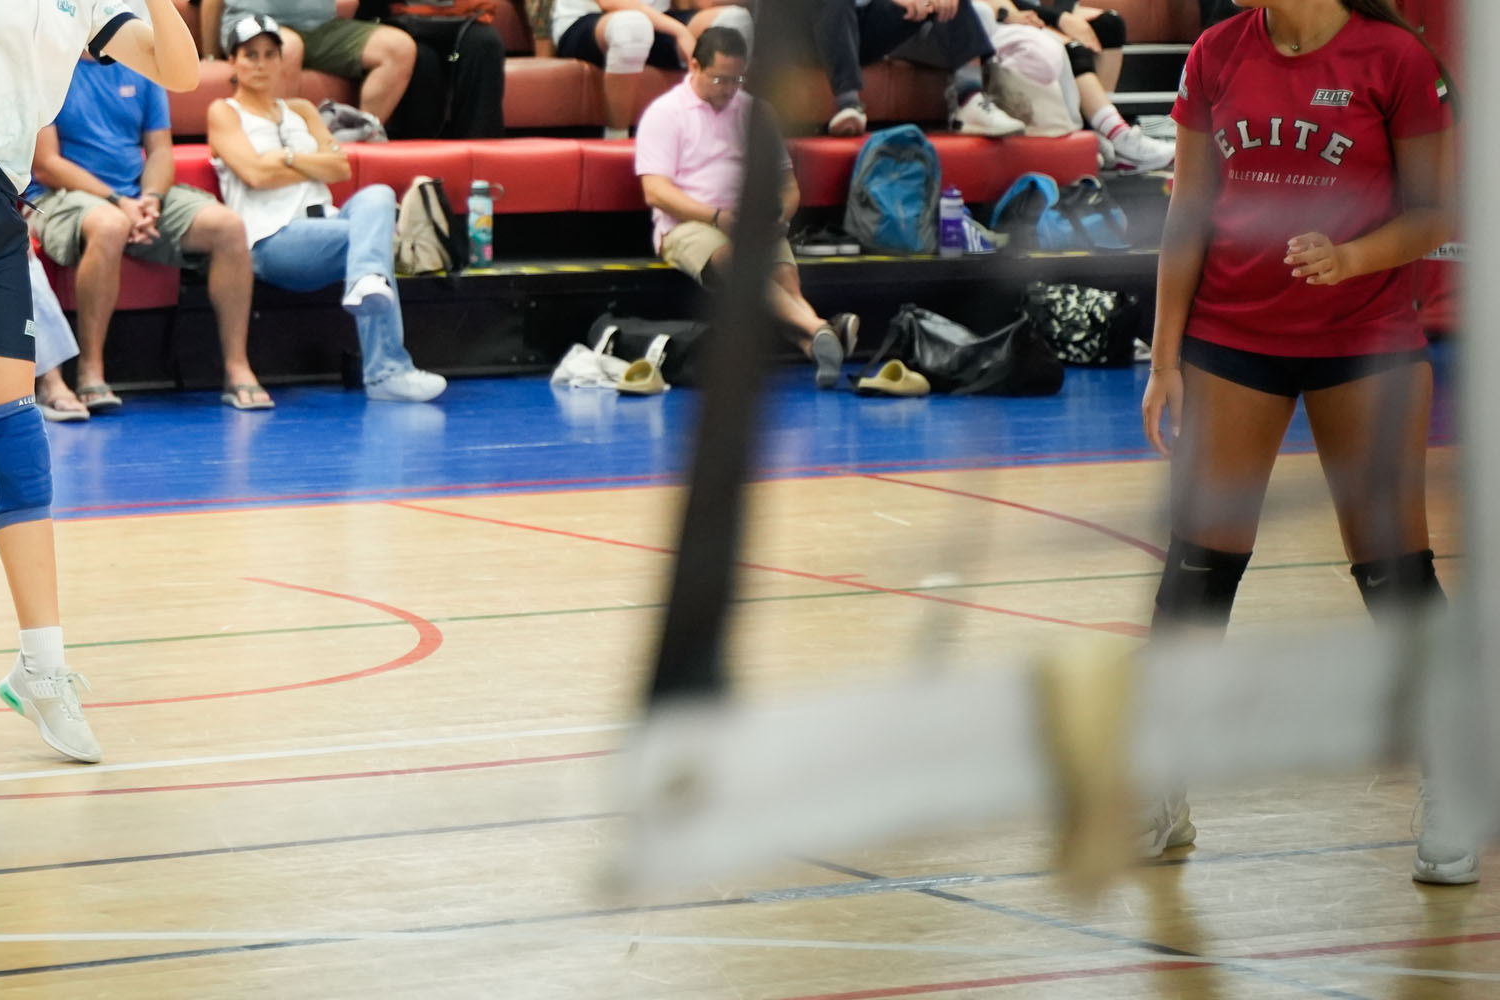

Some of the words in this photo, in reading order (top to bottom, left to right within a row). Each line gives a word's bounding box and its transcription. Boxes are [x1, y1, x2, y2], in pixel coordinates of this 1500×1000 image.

[1316, 91, 1349, 101] ELITE
[1213, 117, 1354, 166] ELITE
[1285, 173, 1337, 187] ACADEMY
